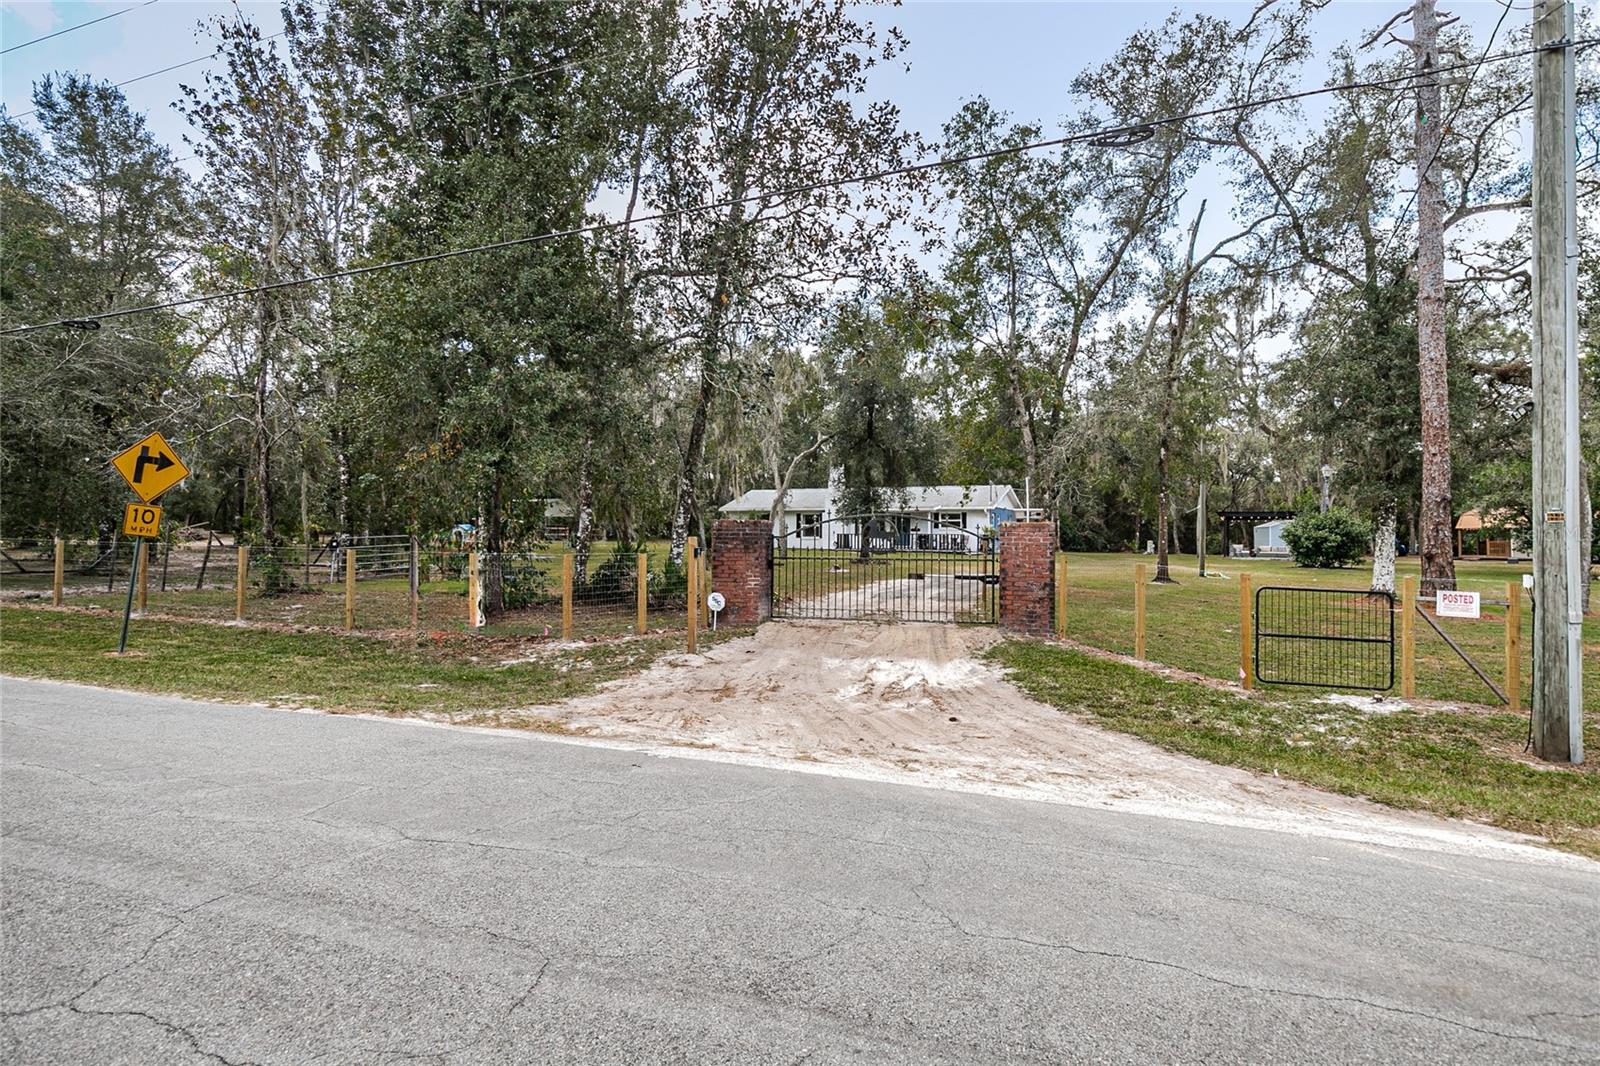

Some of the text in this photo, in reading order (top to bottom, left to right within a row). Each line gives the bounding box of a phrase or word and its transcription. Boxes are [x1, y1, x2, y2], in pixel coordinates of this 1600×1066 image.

[133, 508, 155, 524] 10
[131, 525, 152, 533] MPH
[1443, 594, 1474, 605] POSTED
